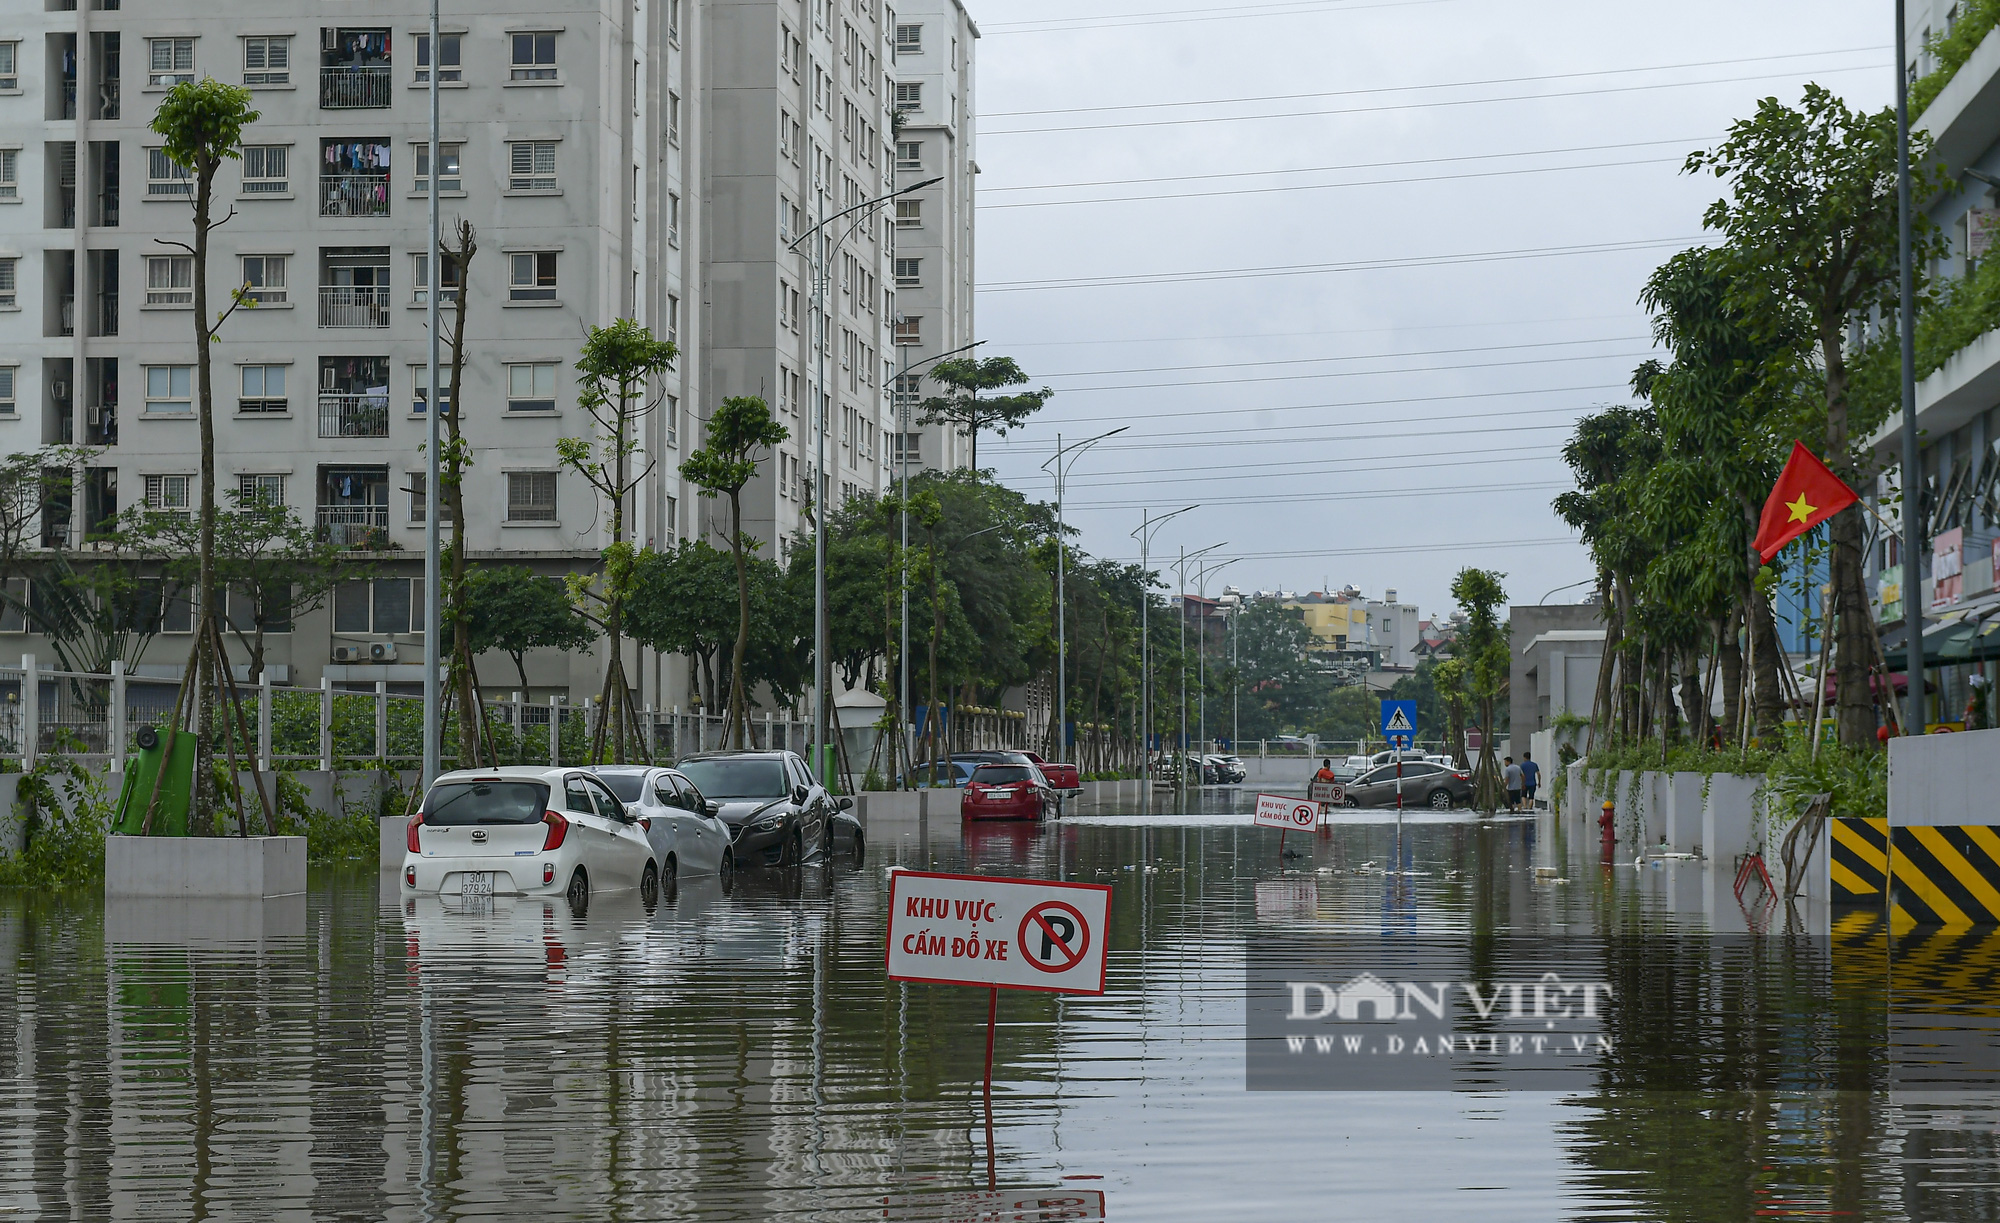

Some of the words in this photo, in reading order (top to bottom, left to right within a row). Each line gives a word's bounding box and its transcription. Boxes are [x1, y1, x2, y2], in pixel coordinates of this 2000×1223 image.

[1298, 809, 1309, 822] P
[463, 884, 491, 894] 379.24
[470, 873, 486, 883] 30A
[906, 896, 950, 919] KHU
[954, 899, 996, 928] VỰC
[903, 929, 946, 956] CẤM
[951, 930, 980, 959] ĐỖ
[984, 940, 1008, 961] XE
[1040, 915, 1075, 960] P
